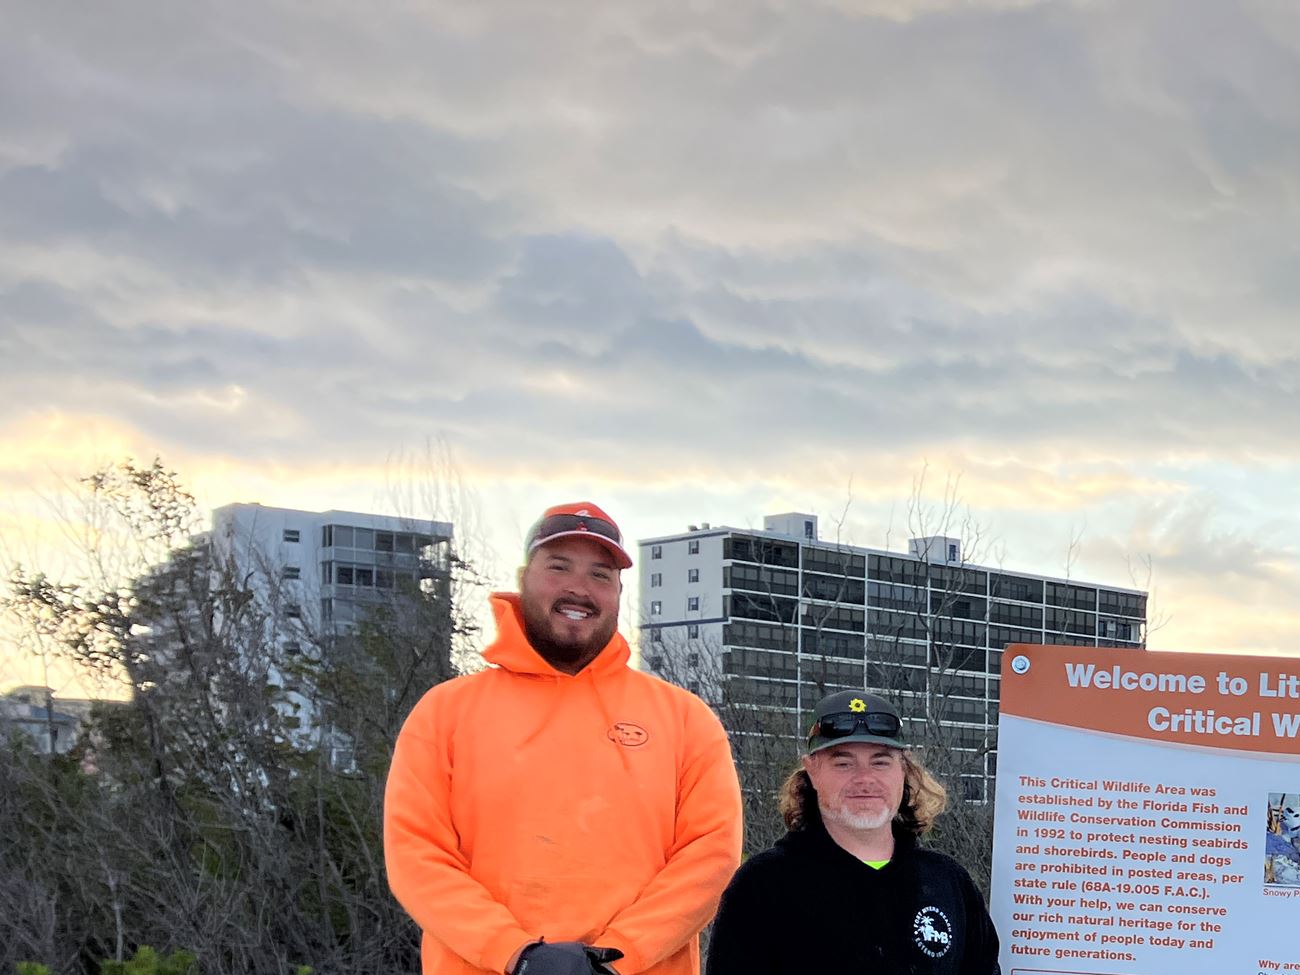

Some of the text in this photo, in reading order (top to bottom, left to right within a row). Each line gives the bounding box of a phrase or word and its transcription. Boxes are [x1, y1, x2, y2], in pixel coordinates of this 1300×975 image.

[1065, 664, 1205, 693] Welcome
[1217, 672, 1248, 695] to
[1148, 707, 1260, 736] Critical
[1019, 776, 1216, 797] This Critical Wildlife Area was
[1018, 794, 1248, 816] established by the Florida Fish and
[1017, 810, 1241, 832] Wildlife Conservation Commission
[1017, 827, 1248, 849] in 1992 to protect nesting seabirds
[1016, 845, 1231, 868] and shorebirds. People and dogs
[1015, 863, 1244, 884] are prohibited in posted areas, per
[1014, 878, 1210, 900] state rule (68A-19.005 F.A.C.).
[1263, 888, 1292, 899] Snowy
[1013, 894, 1227, 916] With your help, we can conserve
[1012, 912, 1221, 933] our rich natural heritage for the
[928, 929, 948, 944] FMB
[1012, 928, 1213, 949] enjoyment of people today and
[1011, 944, 1136, 961] future generations.
[1259, 960, 1280, 971] Why
